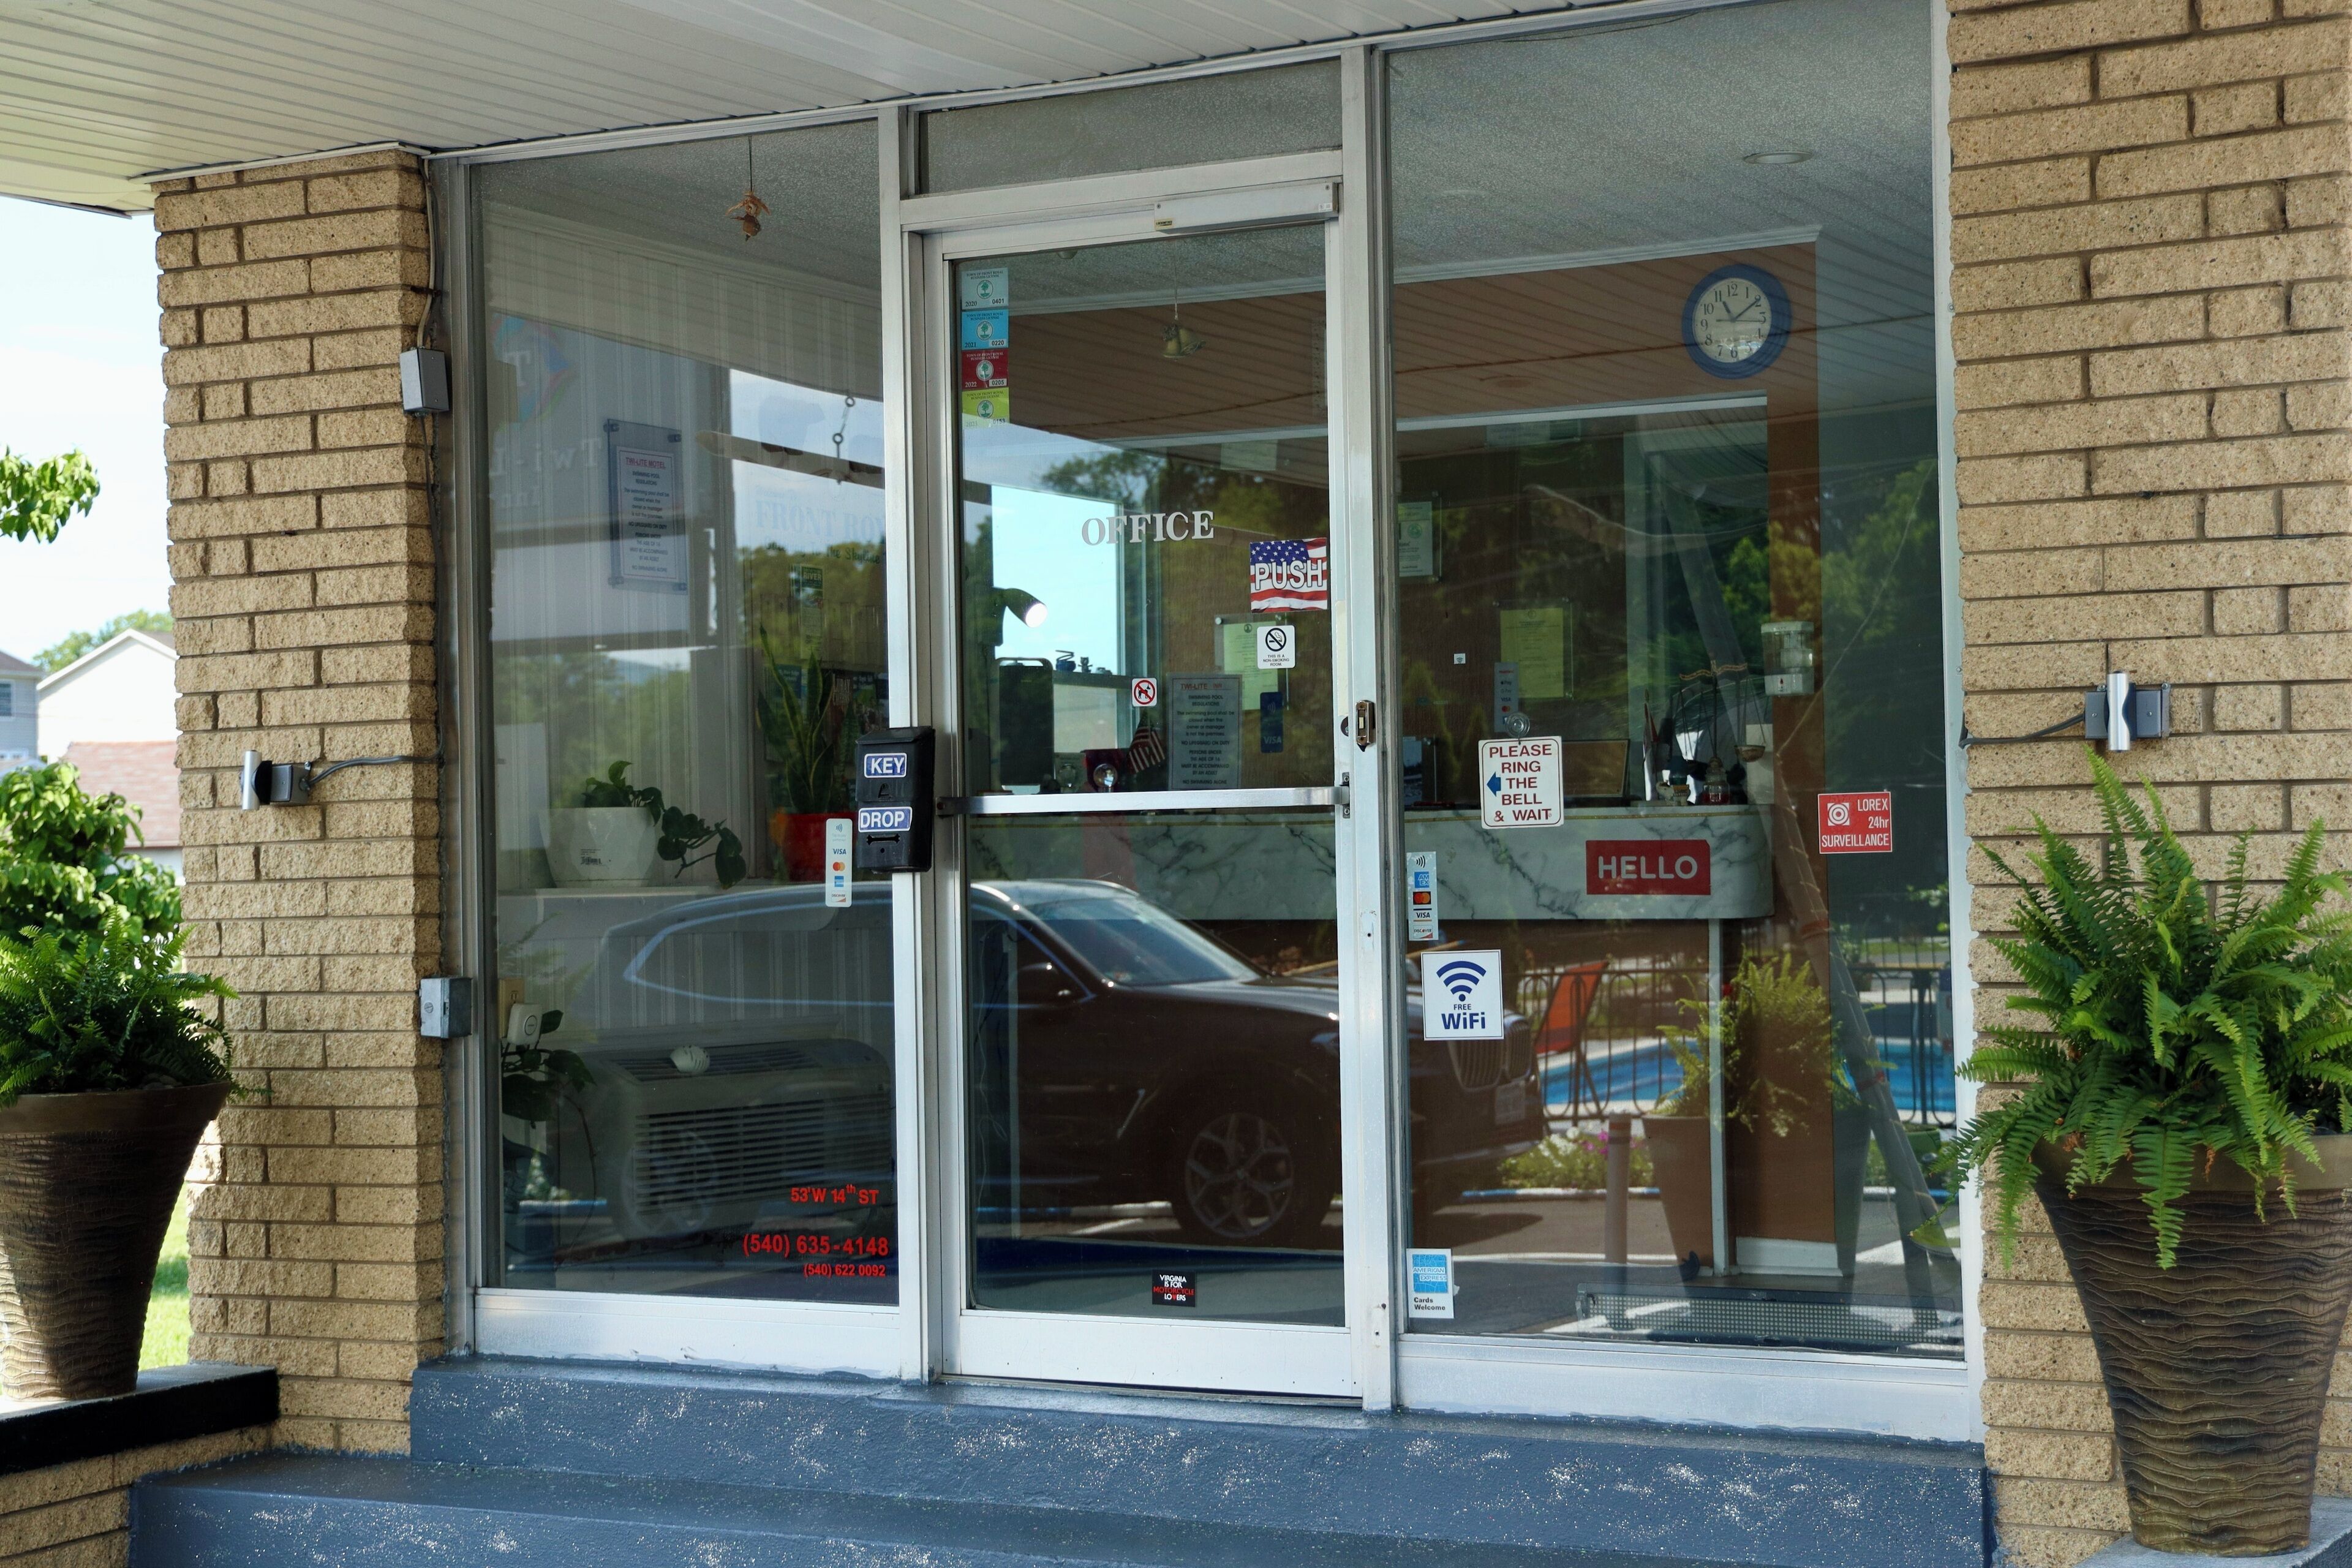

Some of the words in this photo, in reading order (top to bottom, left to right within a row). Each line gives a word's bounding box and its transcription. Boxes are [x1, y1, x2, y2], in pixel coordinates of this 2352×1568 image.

[1715, 290, 1722, 303] 11
[1727, 284, 1738, 297] 12
[1754, 295, 1762, 307] 2
[1704, 303, 1714, 315] 10
[1700, 318, 1708, 331] 9
[1705, 334, 1713, 346] 8
[1717, 345, 1723, 356] 7
[1730, 347, 1738, 358] 6
[1082, 510, 1215, 546] OFFICE
[803, 571, 822, 581] RIVER
[1254, 558, 1324, 591] PUSH
[1489, 744, 1552, 758] PLEASE
[871, 757, 905, 774] KEY
[1501, 761, 1541, 774] RING
[1505, 777, 1538, 790] THE
[1501, 793, 1542, 806] BELL
[1857, 798, 1888, 812] LOREX
[860, 811, 905, 829] DROP
[1493, 810, 1505, 822] &
[1512, 808, 1552, 821] WAIT
[1868, 816, 1890, 829] 24hr
[1821, 833, 1890, 848] SURVEILLANCE
[1598, 855, 1698, 880] HELLO
[1441, 1011, 1486, 1030] WiFi
[858, 1189, 880, 1205] ST
[742, 1233, 790, 1257] (540)
[804, 1263, 832, 1278] (540)
[835, 1264, 856, 1276] 622
[858, 1264, 886, 1277] 0092
[1159, 1274, 1187, 1283] VIRGINIA
[1153, 1286, 1194, 1295] MOTORCYCLE
